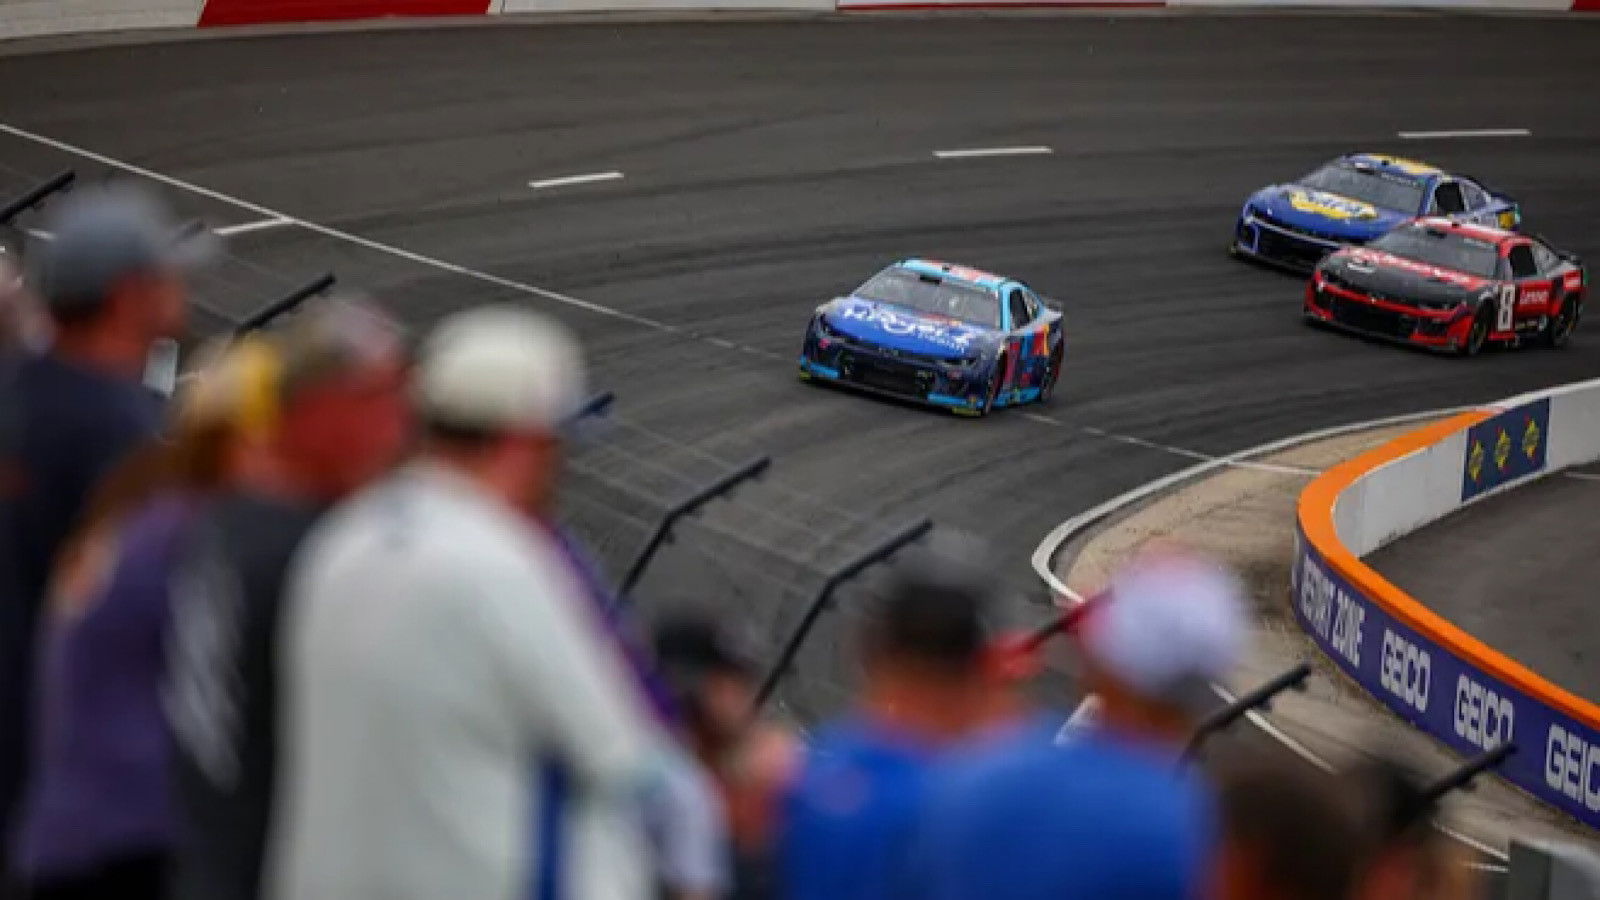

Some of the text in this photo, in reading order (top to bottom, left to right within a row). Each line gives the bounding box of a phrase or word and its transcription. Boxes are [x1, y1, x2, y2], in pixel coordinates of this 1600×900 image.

[1498, 284, 1515, 332] 8
[1381, 629, 1431, 713] GEICO
[1455, 675, 1513, 751] GEICO
